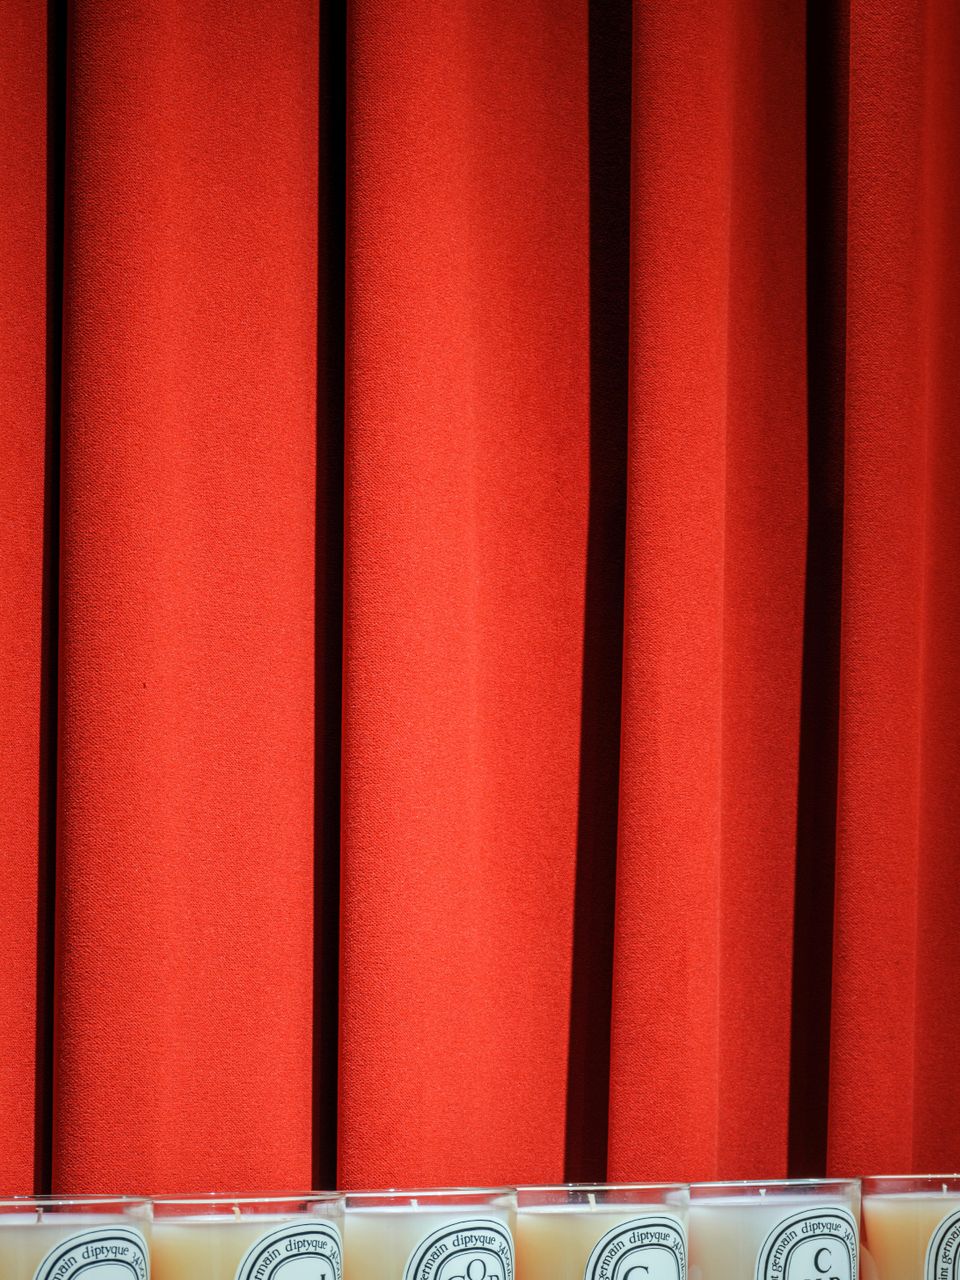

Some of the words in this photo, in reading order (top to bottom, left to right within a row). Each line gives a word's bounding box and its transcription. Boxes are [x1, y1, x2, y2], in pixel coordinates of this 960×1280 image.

[801, 1220, 842, 1236] diptyque
[452, 1233, 496, 1248] diptyque
[629, 1230, 671, 1245] diptyque
[82, 1245, 129, 1259] diptyque
[285, 1239, 328, 1253] diptyque
